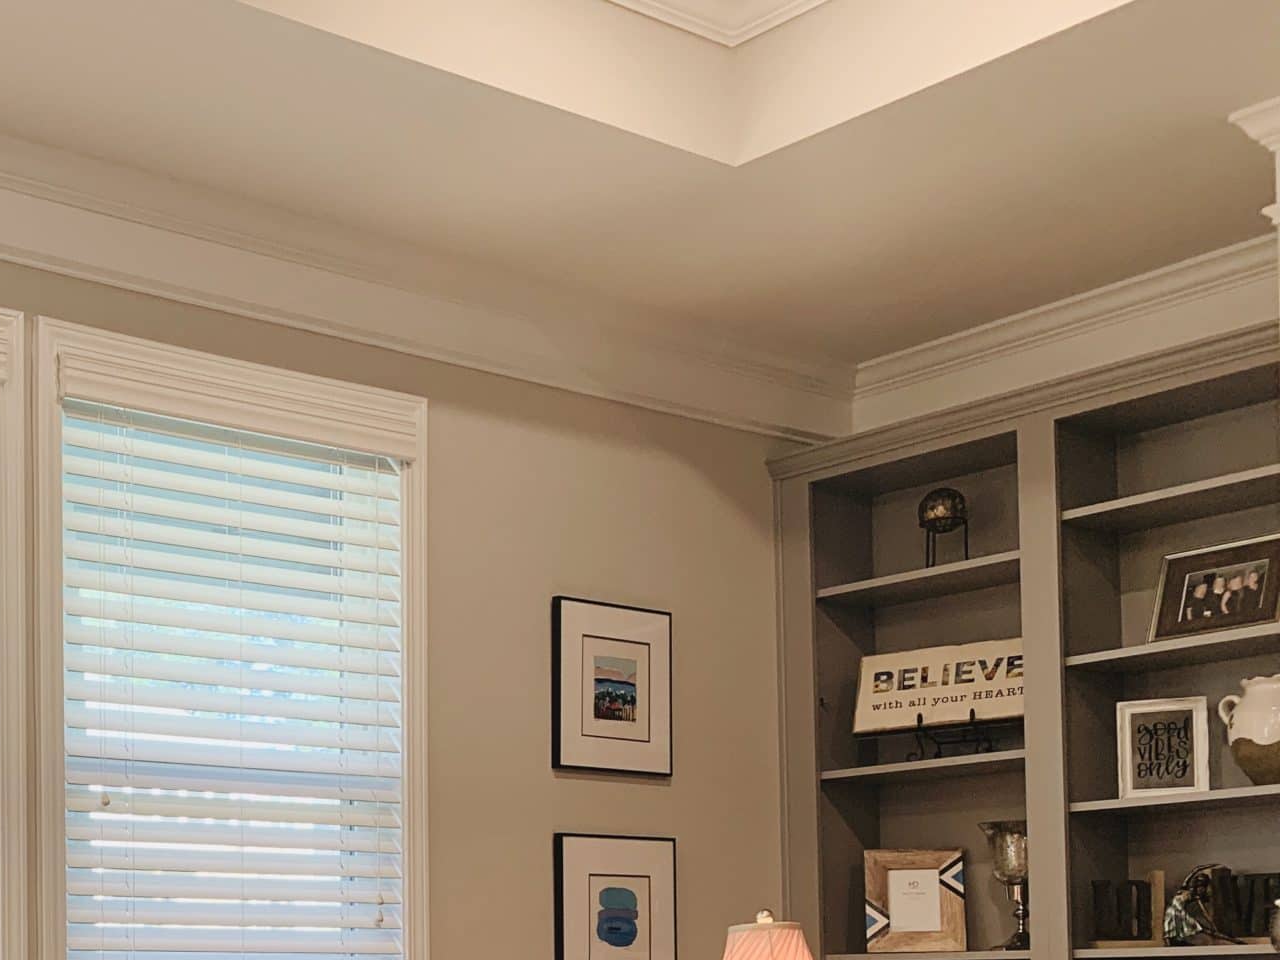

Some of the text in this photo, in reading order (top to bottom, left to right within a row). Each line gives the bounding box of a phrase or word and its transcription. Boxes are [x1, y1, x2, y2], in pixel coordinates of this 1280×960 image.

[872, 655, 1024, 694] BELIEVE
[872, 699, 903, 711] with
[908, 697, 926, 708] all
[931, 694, 968, 707] your
[1137, 717, 1189, 745] good
[1137, 754, 1189, 780] only
